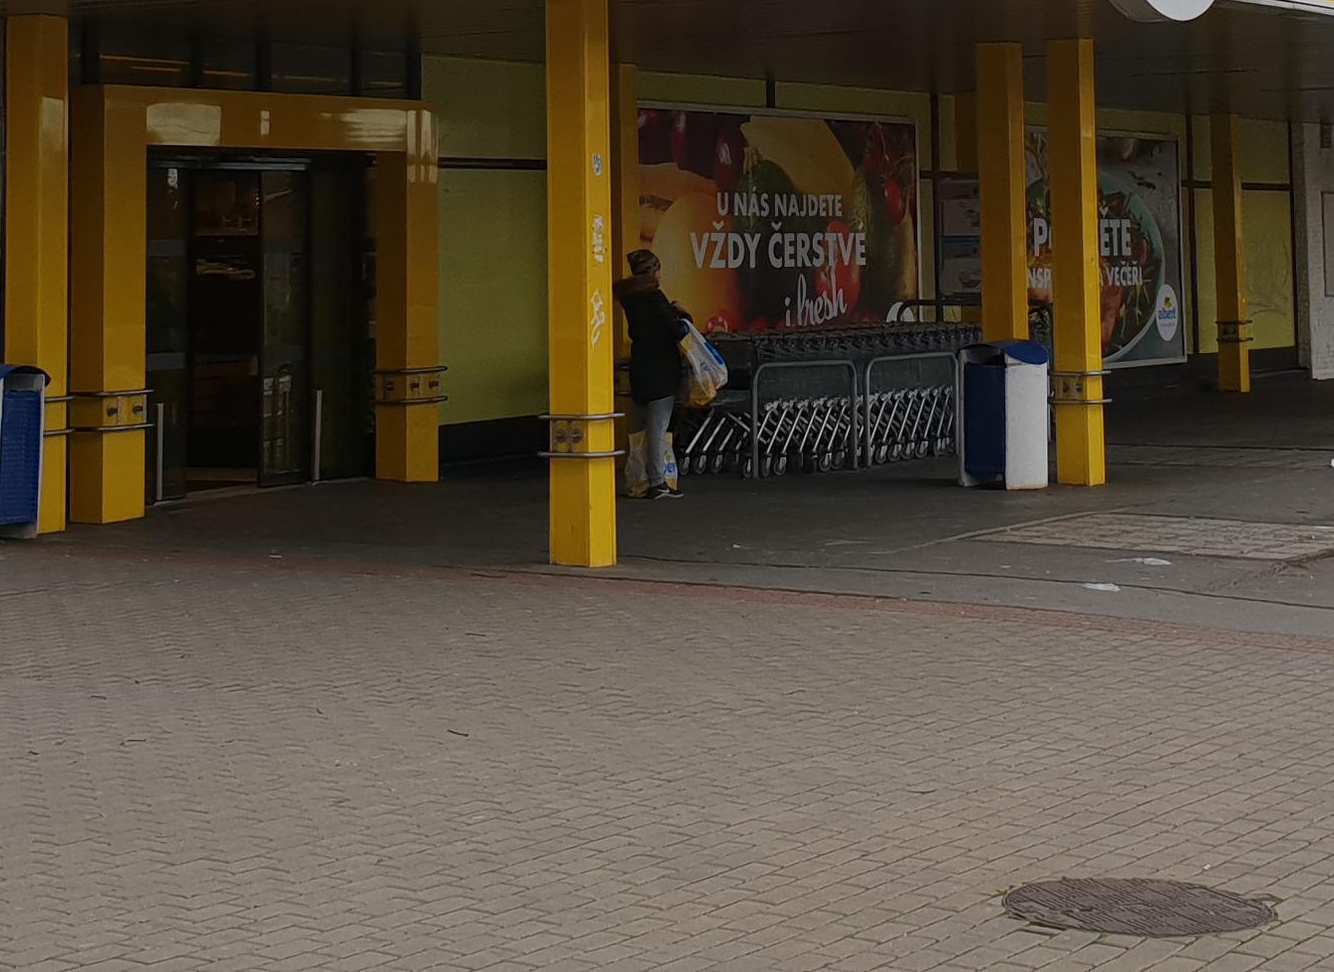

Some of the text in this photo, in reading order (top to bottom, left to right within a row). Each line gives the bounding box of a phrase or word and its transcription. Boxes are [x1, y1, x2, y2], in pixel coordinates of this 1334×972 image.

[717, 185, 843, 217] U NÁS NAJDETE
[690, 221, 867, 269] VŽDY ČERSTVÉ
[1107, 260, 1143, 287] VEČEŘI
[797, 268, 848, 326] fresh
